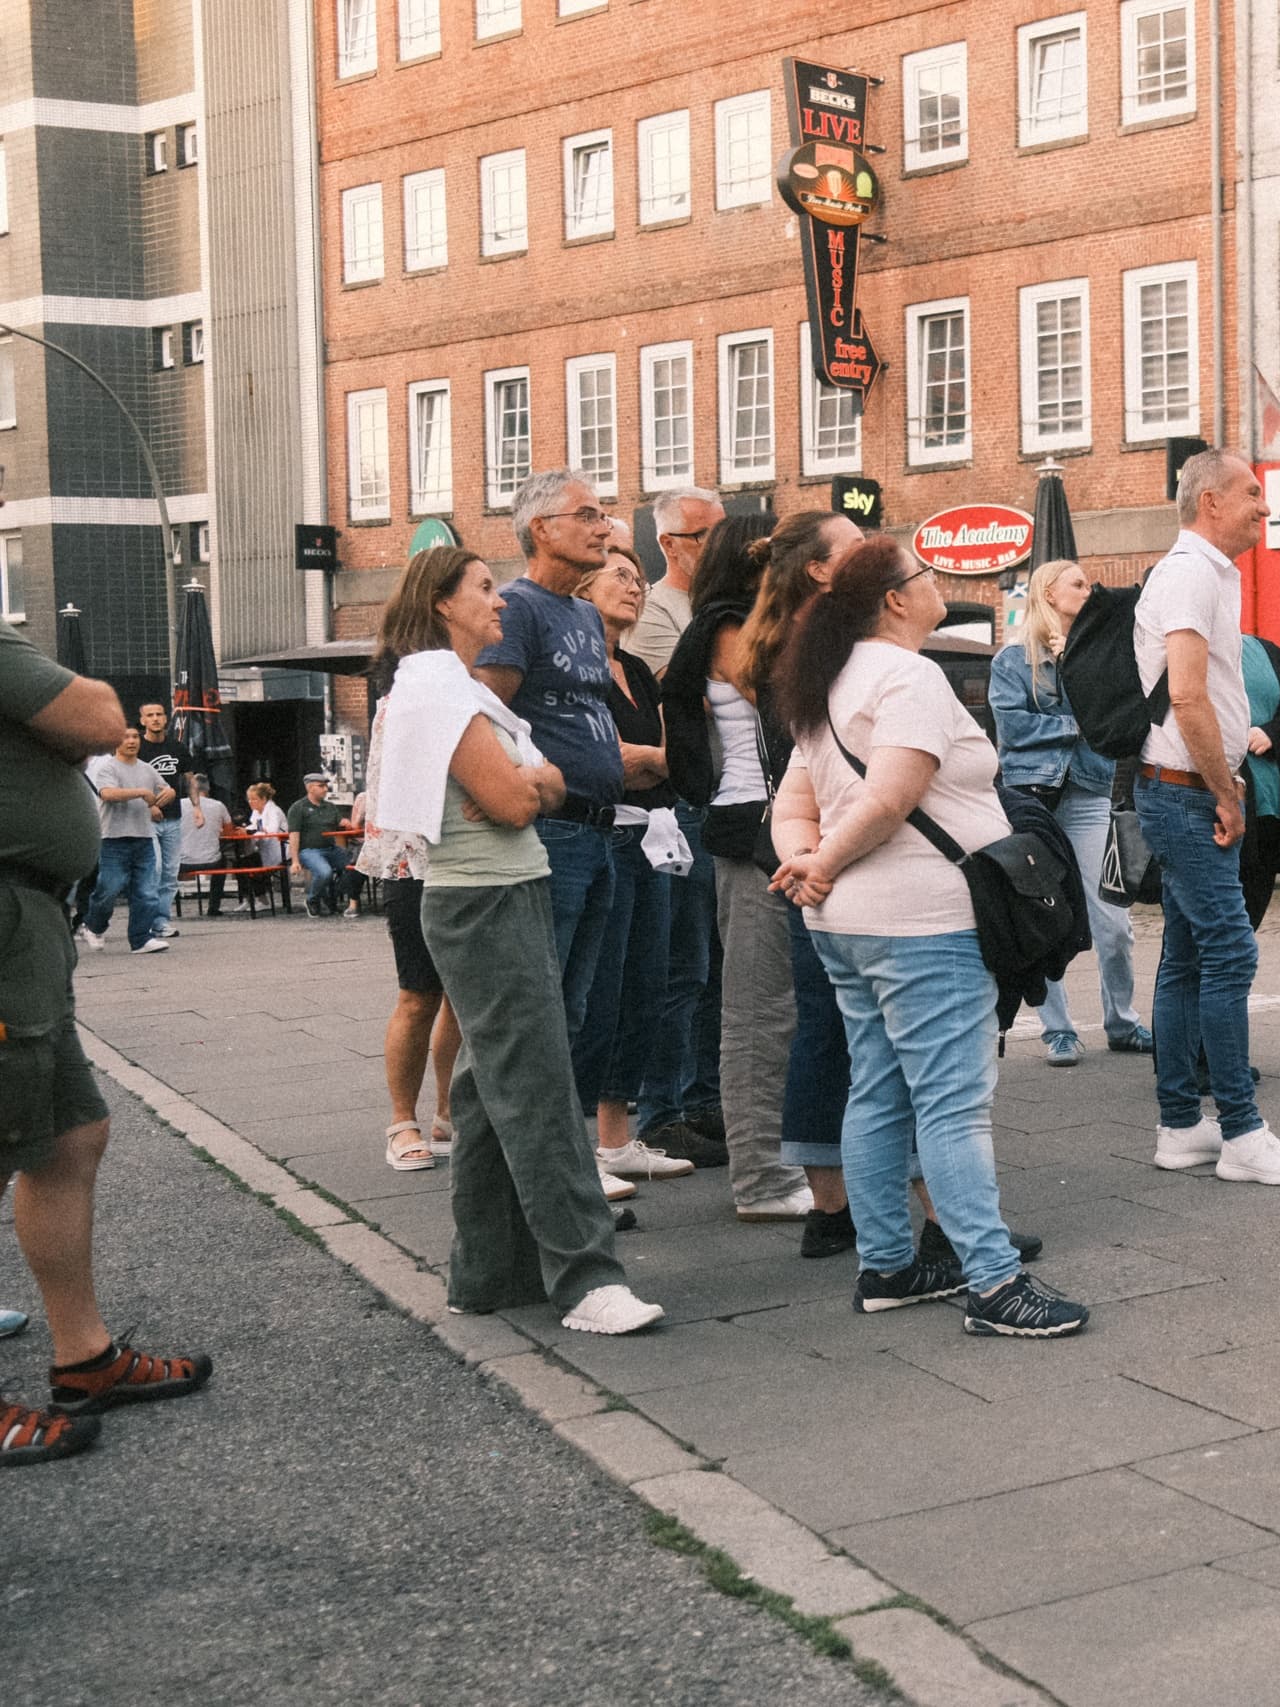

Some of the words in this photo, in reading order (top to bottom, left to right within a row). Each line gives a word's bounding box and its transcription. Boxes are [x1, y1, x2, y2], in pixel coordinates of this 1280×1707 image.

[803, 108, 862, 145] LIVE
[827, 229, 846, 327] MUSIC
[834, 337, 867, 361] free
[829, 361, 873, 385] entry
[842, 487, 876, 516] sky
[921, 525, 952, 549] The
[953, 521, 1030, 546] Academy
[933, 554, 956, 569] LIVE
[960, 557, 992, 570] MUSIC
[578, 664, 604, 684] DRY
